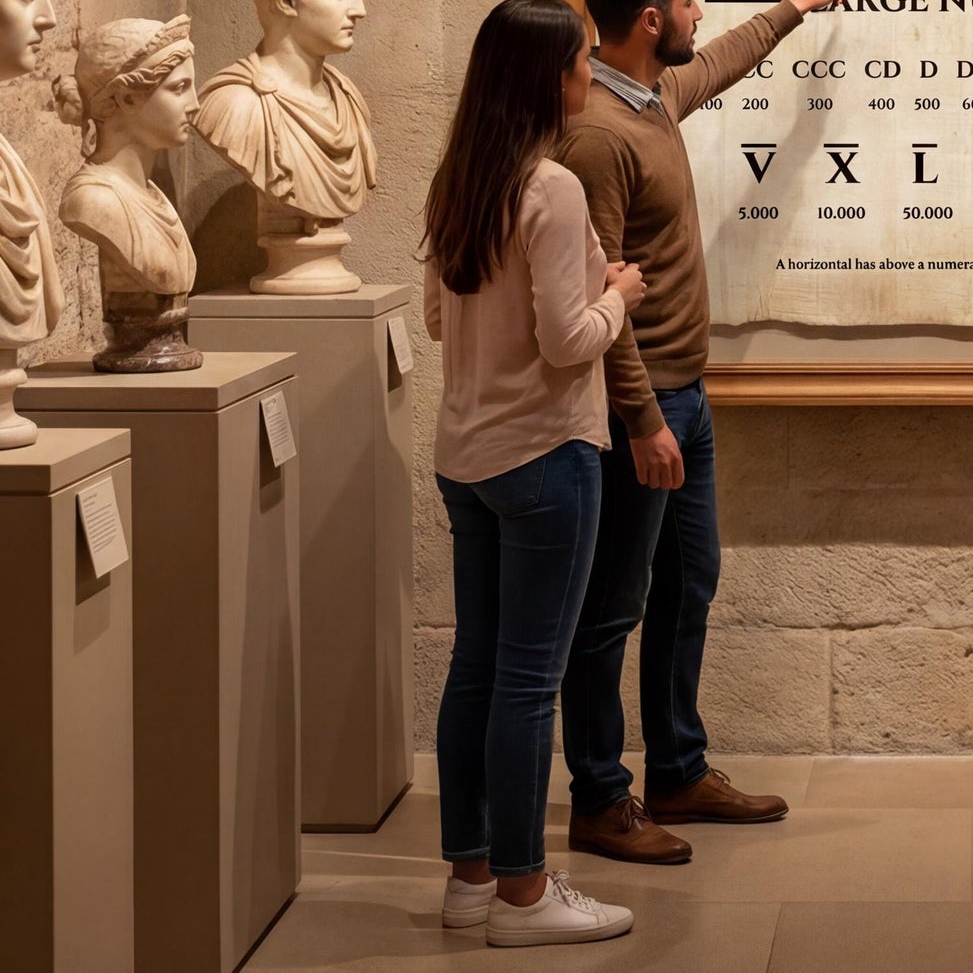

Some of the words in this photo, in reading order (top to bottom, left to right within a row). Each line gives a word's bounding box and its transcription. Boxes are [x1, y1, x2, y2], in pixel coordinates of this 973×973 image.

[792, 59, 846, 79] CCC
[864, 59, 901, 79] CD
[919, 60, 938, 79] D
[741, 97, 769, 111] 200
[806, 97, 834, 111] 300
[868, 97, 896, 111] 400
[914, 97, 941, 111] 500
[738, 206, 779, 220] 5.000
[818, 206, 866, 220] 10.000
[902, 206, 954, 220] 50.000
[775, 258, 786, 270] A
[788, 257, 852, 270] horizontal
[855, 257, 876, 270] has
[878, 257, 915, 270] above
[917, 261, 925, 270] a
